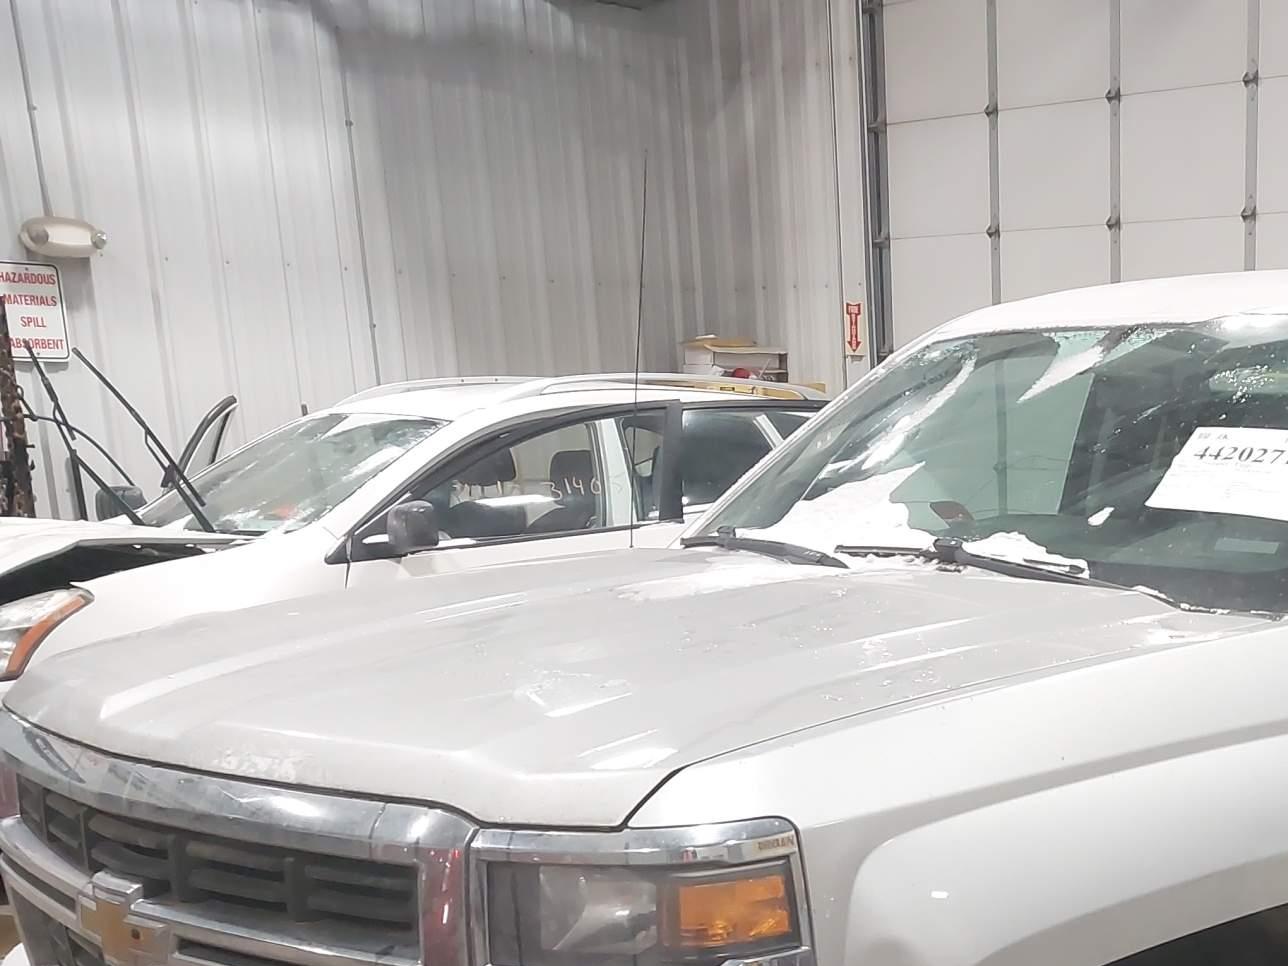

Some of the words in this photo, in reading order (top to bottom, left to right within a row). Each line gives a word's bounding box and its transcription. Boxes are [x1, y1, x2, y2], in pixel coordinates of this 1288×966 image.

[0, 272, 56, 285] HAZARDOUS
[4, 294, 57, 307] MATERIALS
[20, 316, 47, 328] SPILL
